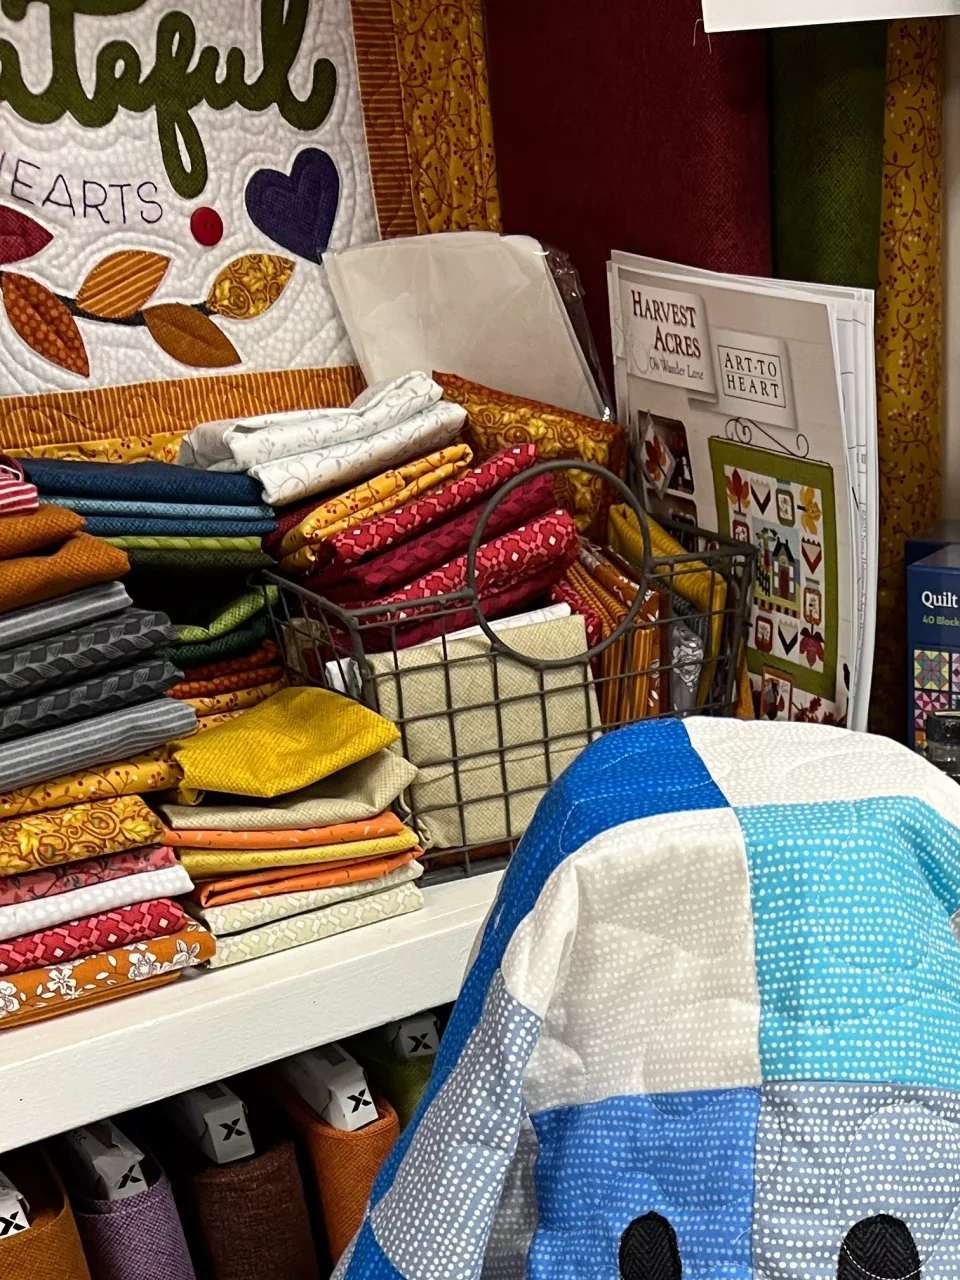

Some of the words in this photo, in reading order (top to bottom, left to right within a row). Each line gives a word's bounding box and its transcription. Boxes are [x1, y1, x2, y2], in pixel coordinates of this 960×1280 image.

[0, 153, 163, 224] EARTS
[630, 289, 697, 329] HARVEST
[653, 325, 701, 358] ACRES
[650, 356, 660, 371] On
[661, 359, 686, 376] Wander
[687, 364, 705, 380] Lane
[726, 374, 780, 399] HEART
[921, 591, 959, 609] Quilt
[922, 615, 935, 625] 40
